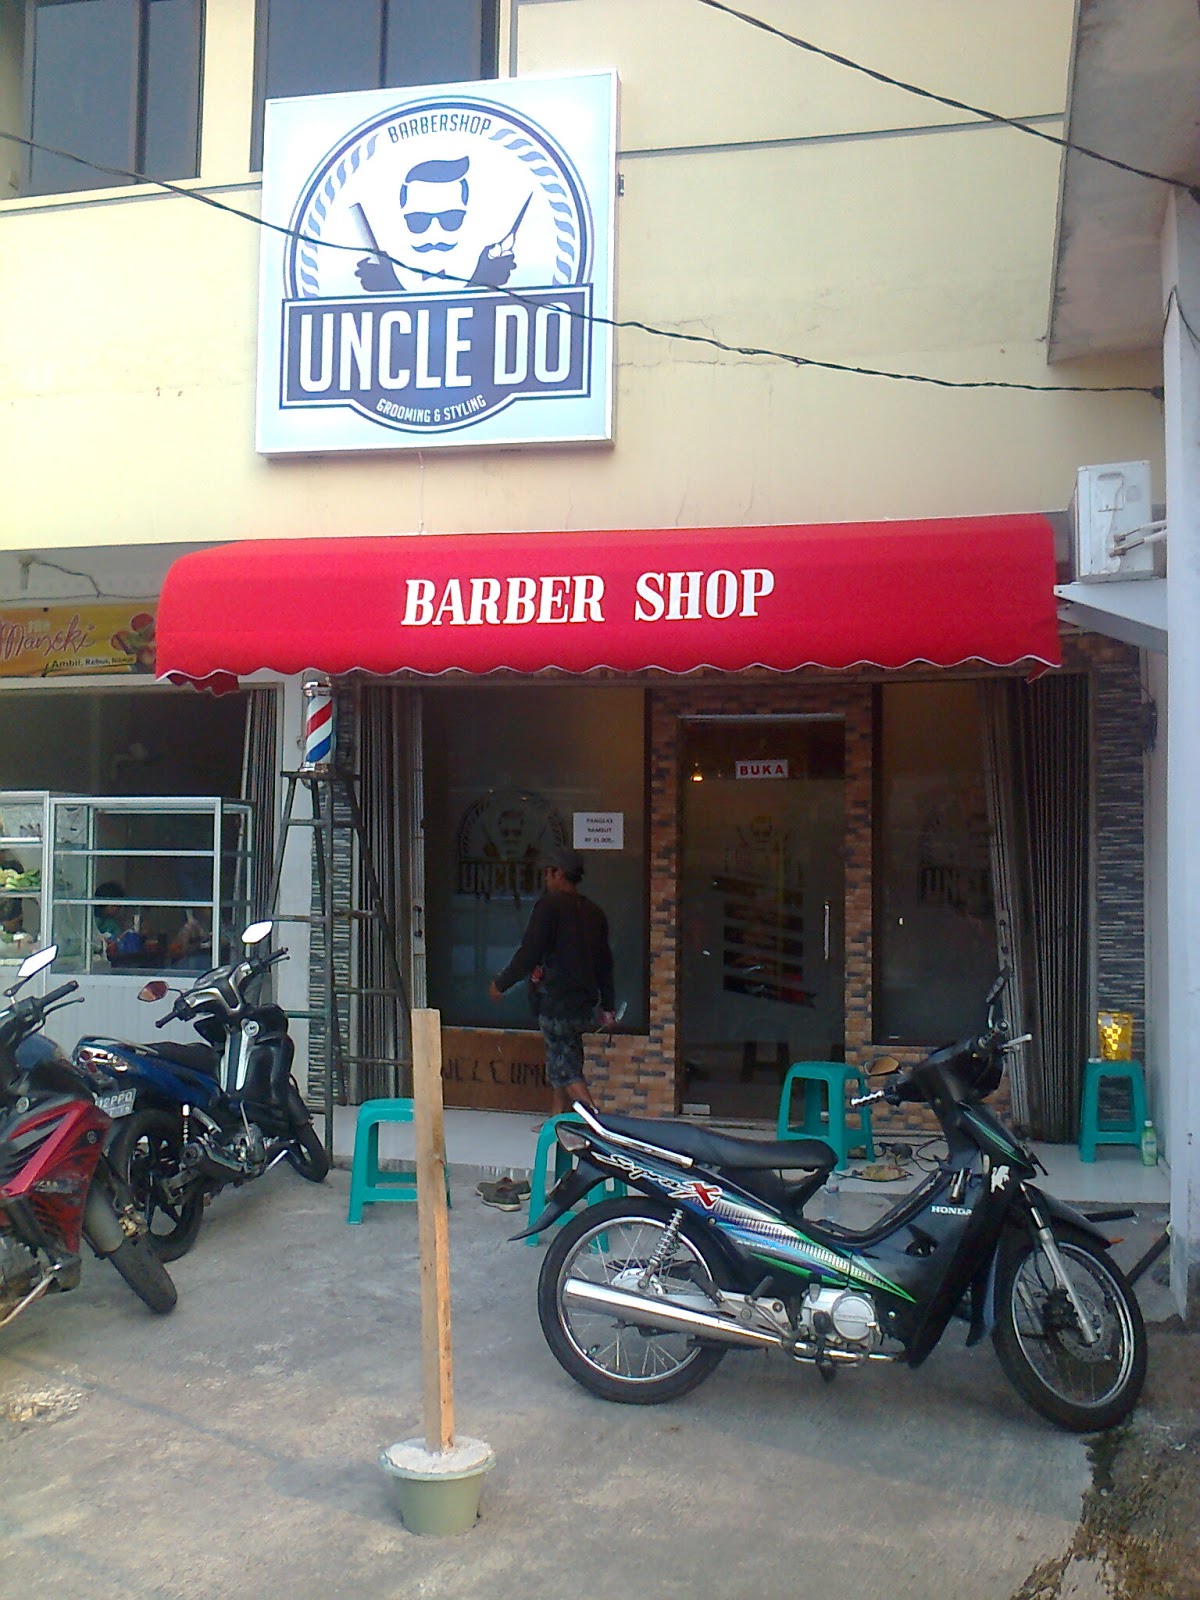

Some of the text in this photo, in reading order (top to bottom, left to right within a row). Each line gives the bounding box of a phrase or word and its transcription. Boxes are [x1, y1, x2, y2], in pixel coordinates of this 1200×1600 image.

[387, 114, 491, 143] BARBERSHOP
[299, 302, 572, 392] UNCLE DO
[376, 395, 487, 423] GROOMING & STYLING
[400, 568, 775, 626] BARBER SHOP
[740, 764, 784, 776] BUKA
[931, 1205, 974, 1216] HONDA
